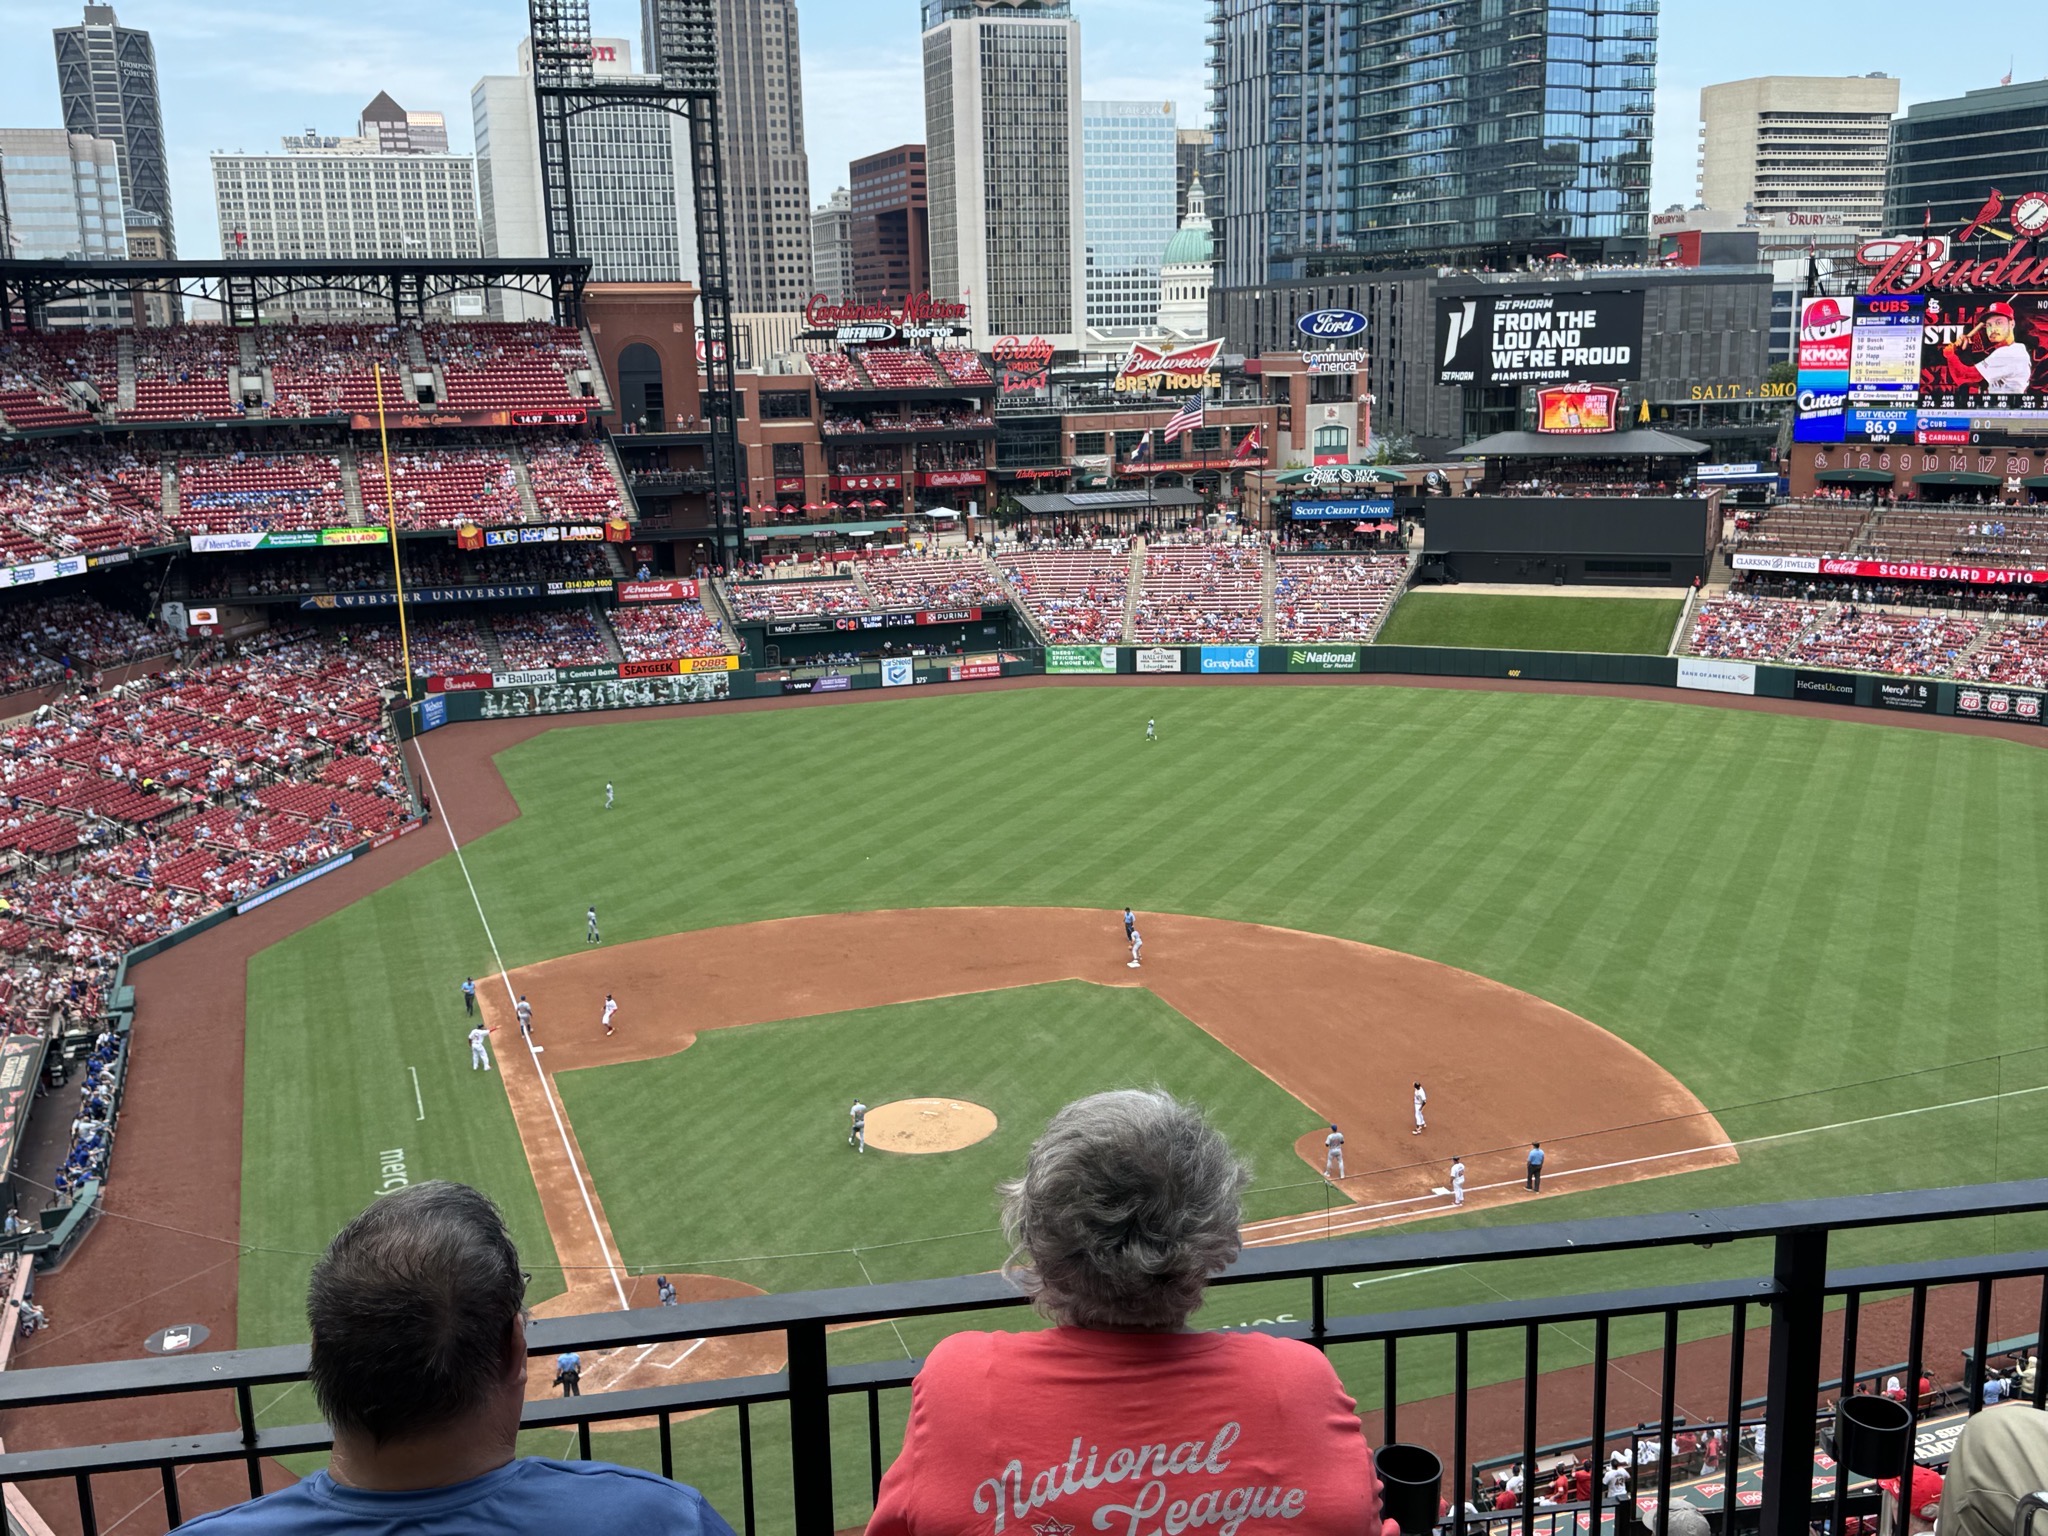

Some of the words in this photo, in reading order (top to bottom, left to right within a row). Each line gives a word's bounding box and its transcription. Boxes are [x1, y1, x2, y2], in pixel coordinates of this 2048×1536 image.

[120, 60, 153, 70] THOMPSON
[124, 69, 149, 78] COBURN
[1653, 215, 1675, 224] DRURY
[1788, 212, 1825, 226] DRURY
[806, 293, 892, 327] Cardinals
[893, 292, 967, 325] Nation
[1869, 300, 1910, 312] CUBS
[1313, 312, 1355, 334] Ford
[1493, 312, 1552, 331] FROM
[1556, 310, 1597, 329] THE
[1900, 316, 1920, 324] 46-51
[837, 327, 886, 338] HOFFMANN
[902, 327, 954, 338] ROOFTOP
[1492, 332, 1532, 350] LOU
[1535, 330, 1581, 348] AND
[992, 335, 1055, 365] Bally
[1801, 348, 1848, 362] KMOX
[1121, 352, 1217, 373] Budweiser
[1302, 350, 1366, 365] Community
[1491, 350, 1557, 369] WE'RE
[1562, 346, 1631, 366] PROUD
[1006, 362, 1040, 372] SPORTS
[1003, 372, 1046, 392] Live!
[1115, 375, 1162, 392] BREW
[1166, 373, 1222, 389] HOUSE
[1491, 370, 1570, 381] #IAM1STPHORM
[1562, 384, 1593, 393] Coca-Cola
[1692, 384, 1740, 400] SALT
[1745, 388, 1754, 398] +
[1760, 382, 1797, 398] SMO
[1800, 392, 1847, 411] Cutter
[1856, 411, 1874, 419] EXIT
[1874, 410, 1908, 418] VELOCITY
[1865, 420, 1898, 434] 86.9
[1870, 434, 1890, 442] MPH
[1844, 453, 1850, 468] 1
[1859, 453, 1870, 469] 2
[1879, 454, 1890, 470] 6
[1900, 454, 1912, 470] 9
[1922, 455, 1938, 471] 10
[1950, 456, 1967, 472] 14
[1978, 456, 1996, 473] 17
[2006, 457, 2030, 474] 20
[1123, 464, 1164, 473] Budweiser
[1294, 506, 1324, 516] SCOTT
[1325, 505, 1358, 515] CREDIT
[1360, 504, 1390, 514] UNION
[486, 530, 518, 546] BIG
[520, 526, 559, 544] MAC
[560, 524, 604, 541] LAND
[1736, 557, 1772, 568] CLARKSON
[1784, 560, 1816, 570] JEWELERS
[1824, 560, 1858, 574] Coca-Cola
[1879, 564, 1980, 580] SCOREBOARD
[1987, 570, 2034, 584] PATIO
[548, 582, 563, 590] TEXT
[564, 580, 582, 589] (314)
[583, 579, 613, 588] 300-1000
[623, 584, 674, 594] Schnucks
[682, 586, 695, 597] 93
[343, 592, 421, 606] WEBSTER
[432, 586, 536, 601] UNIVERSITY
[937, 612, 969, 620] PURINA
[692, 658, 728, 668] DOBBS
[882, 658, 912, 667] CarShield
[1306, 652, 1356, 663] National
[569, 668, 596, 679] Central
[597, 666, 618, 676] Bank
[624, 662, 674, 676] SEATGEEK
[508, 670, 556, 684] Ballpark
[1796, 680, 1853, 694] HeGetsUs.com
[1882, 684, 1904, 696] Mercy
[1963, 698, 1978, 708] 66
[1991, 700, 2005, 710] 66
[2020, 704, 2034, 713] 66
[973, 1421, 1241, 1536] National
[1093, 1480, 1306, 1536] League
